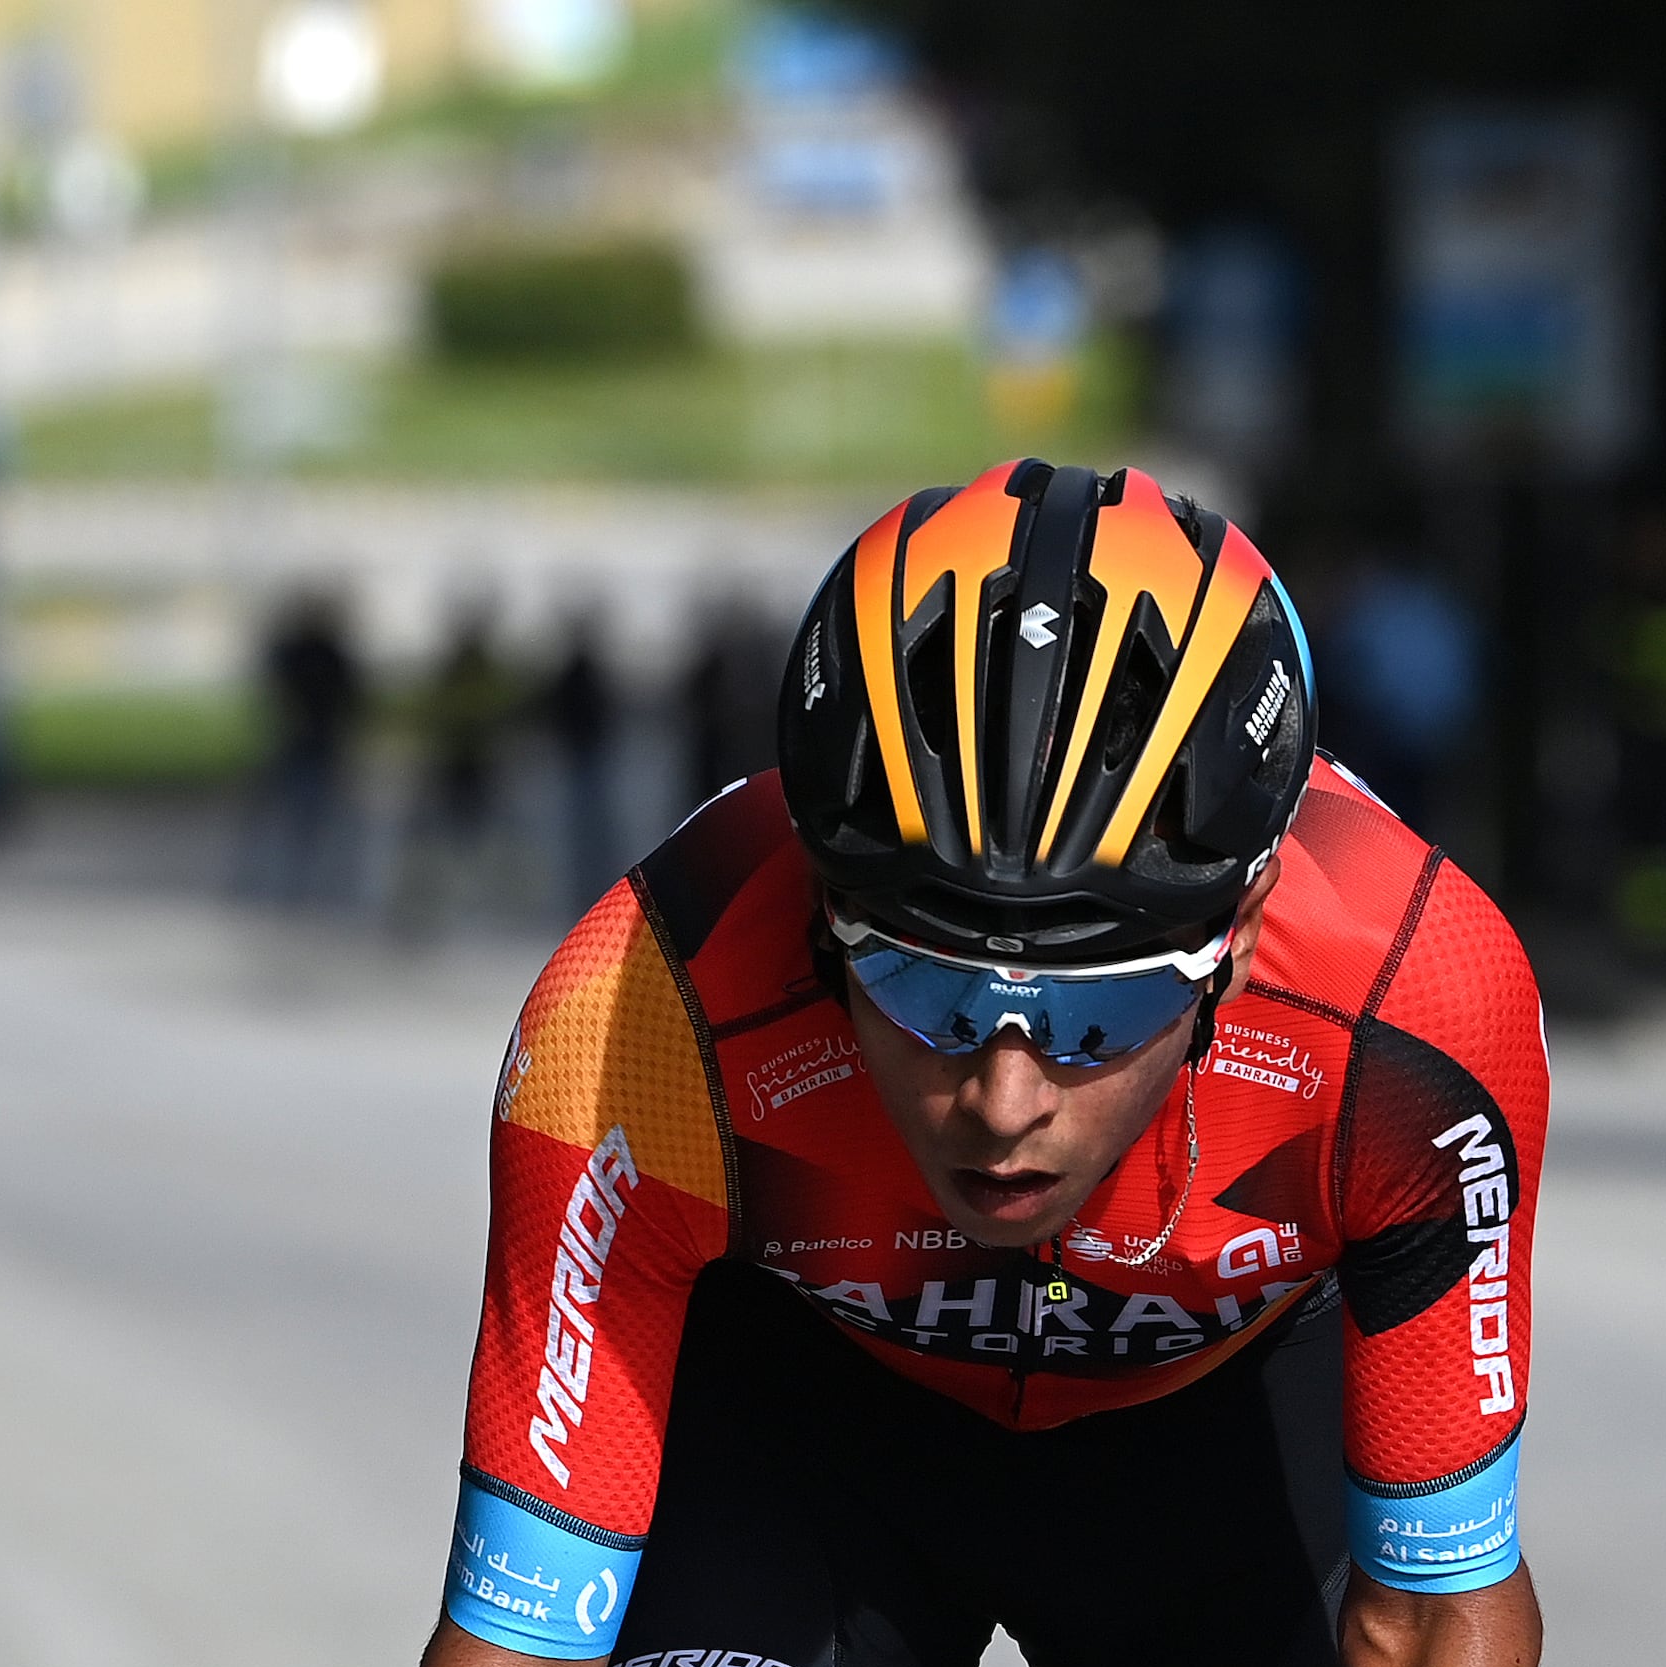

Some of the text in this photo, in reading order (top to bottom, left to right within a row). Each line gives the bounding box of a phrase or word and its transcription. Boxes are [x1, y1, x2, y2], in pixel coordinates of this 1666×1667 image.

[1245, 673, 1281, 737] BAHRAIN
[989, 982, 1043, 998] RUDY
[1224, 1022, 1291, 1048] BUSINESS
[761, 1038, 821, 1074] BUSINESS
[747, 1035, 866, 1121] friendly
[780, 1068, 842, 1102] BAHRAIN
[1223, 1062, 1288, 1088] BAHRAIN
[791, 1236, 873, 1253] Batelco
[894, 1229, 968, 1250] NBB
[1123, 1234, 1155, 1250] UC
[1432, 1113, 1515, 1415] MERIDA
[529, 1122, 639, 1489] MERIDA
[778, 1270, 1329, 1335] AHRAI
[1378, 1497, 1502, 1538] السلام
[1381, 1530, 1506, 1562] Al Salam
[477, 1576, 551, 1622] Bank
